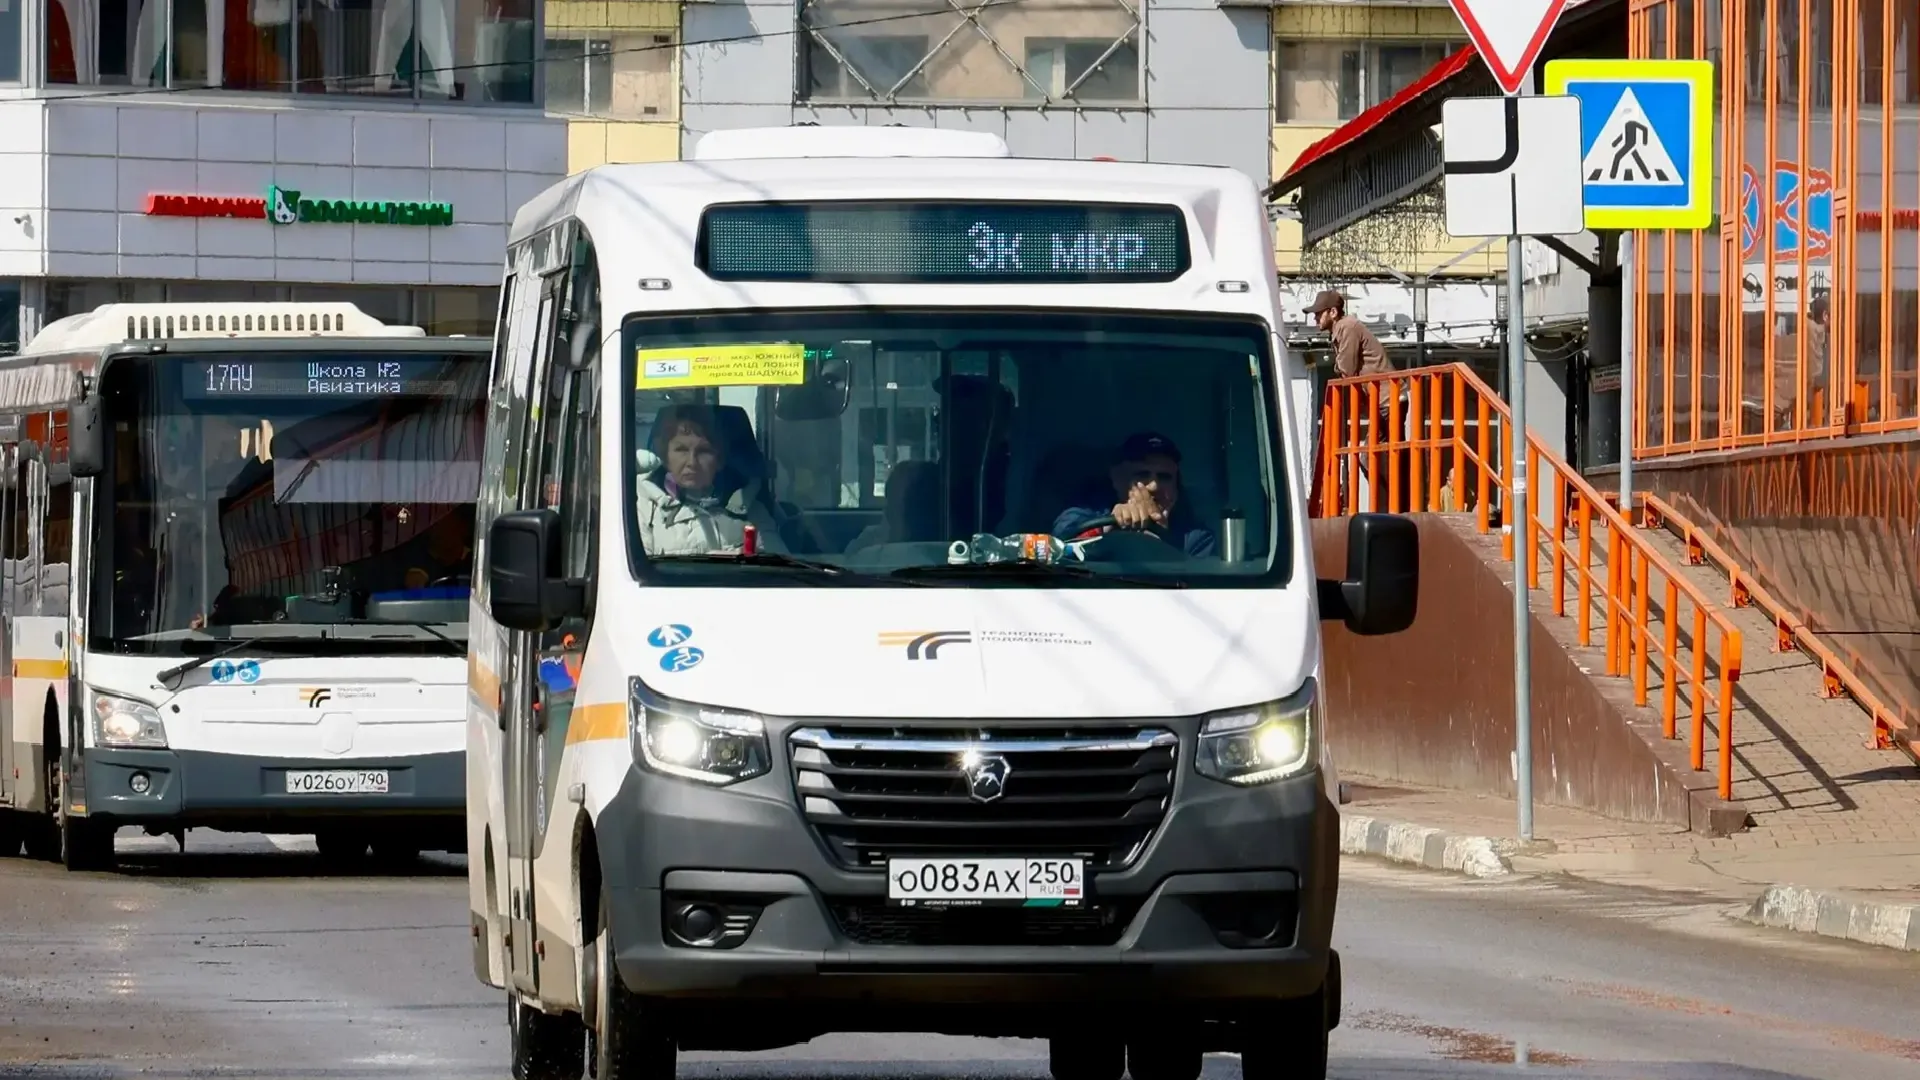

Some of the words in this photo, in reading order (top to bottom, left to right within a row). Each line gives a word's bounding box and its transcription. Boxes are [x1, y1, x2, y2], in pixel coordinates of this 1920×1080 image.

[307, 362, 367, 378] Школа
[307, 378, 401, 394] Авиатика
[359, 773, 384, 785] 790
[1028, 862, 1074, 884] 250
[1039, 884, 1062, 894] RUS
